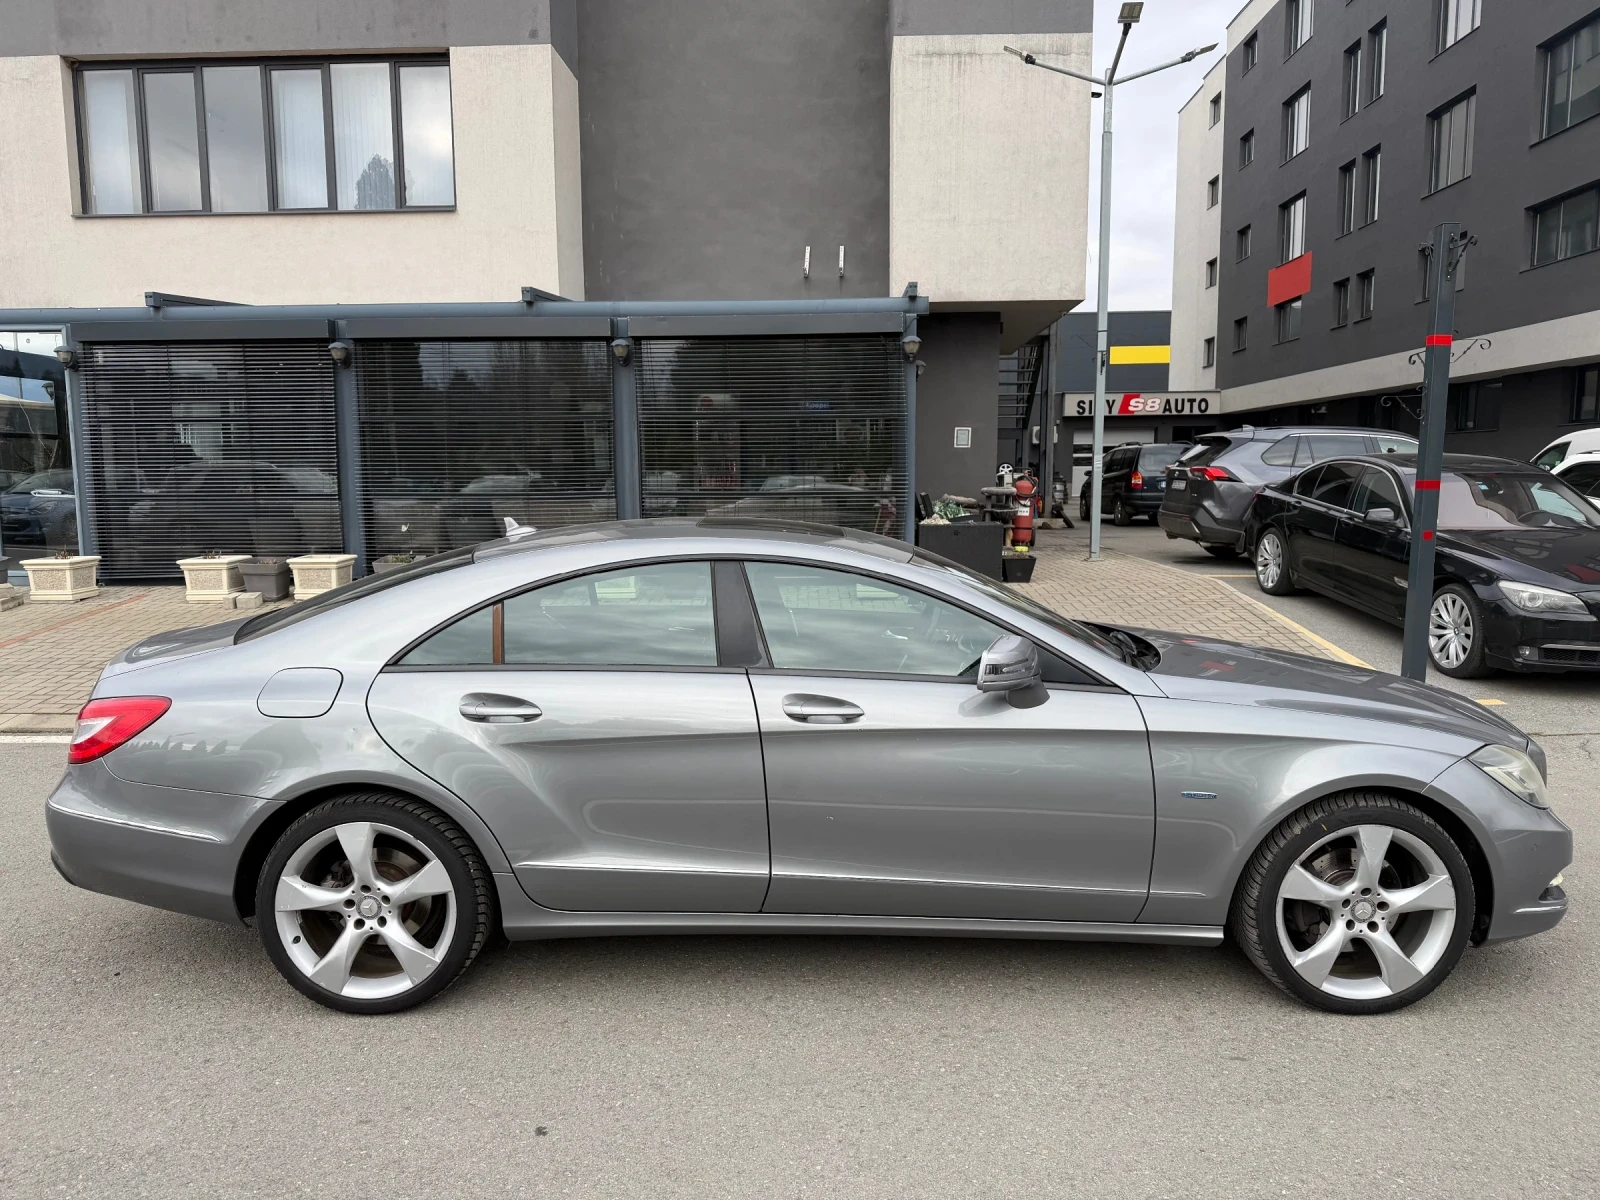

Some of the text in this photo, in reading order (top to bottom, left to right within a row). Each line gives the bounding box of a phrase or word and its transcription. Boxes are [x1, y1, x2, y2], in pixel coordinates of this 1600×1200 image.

[1076, 397, 1209, 416] SIY S8 AUTO
